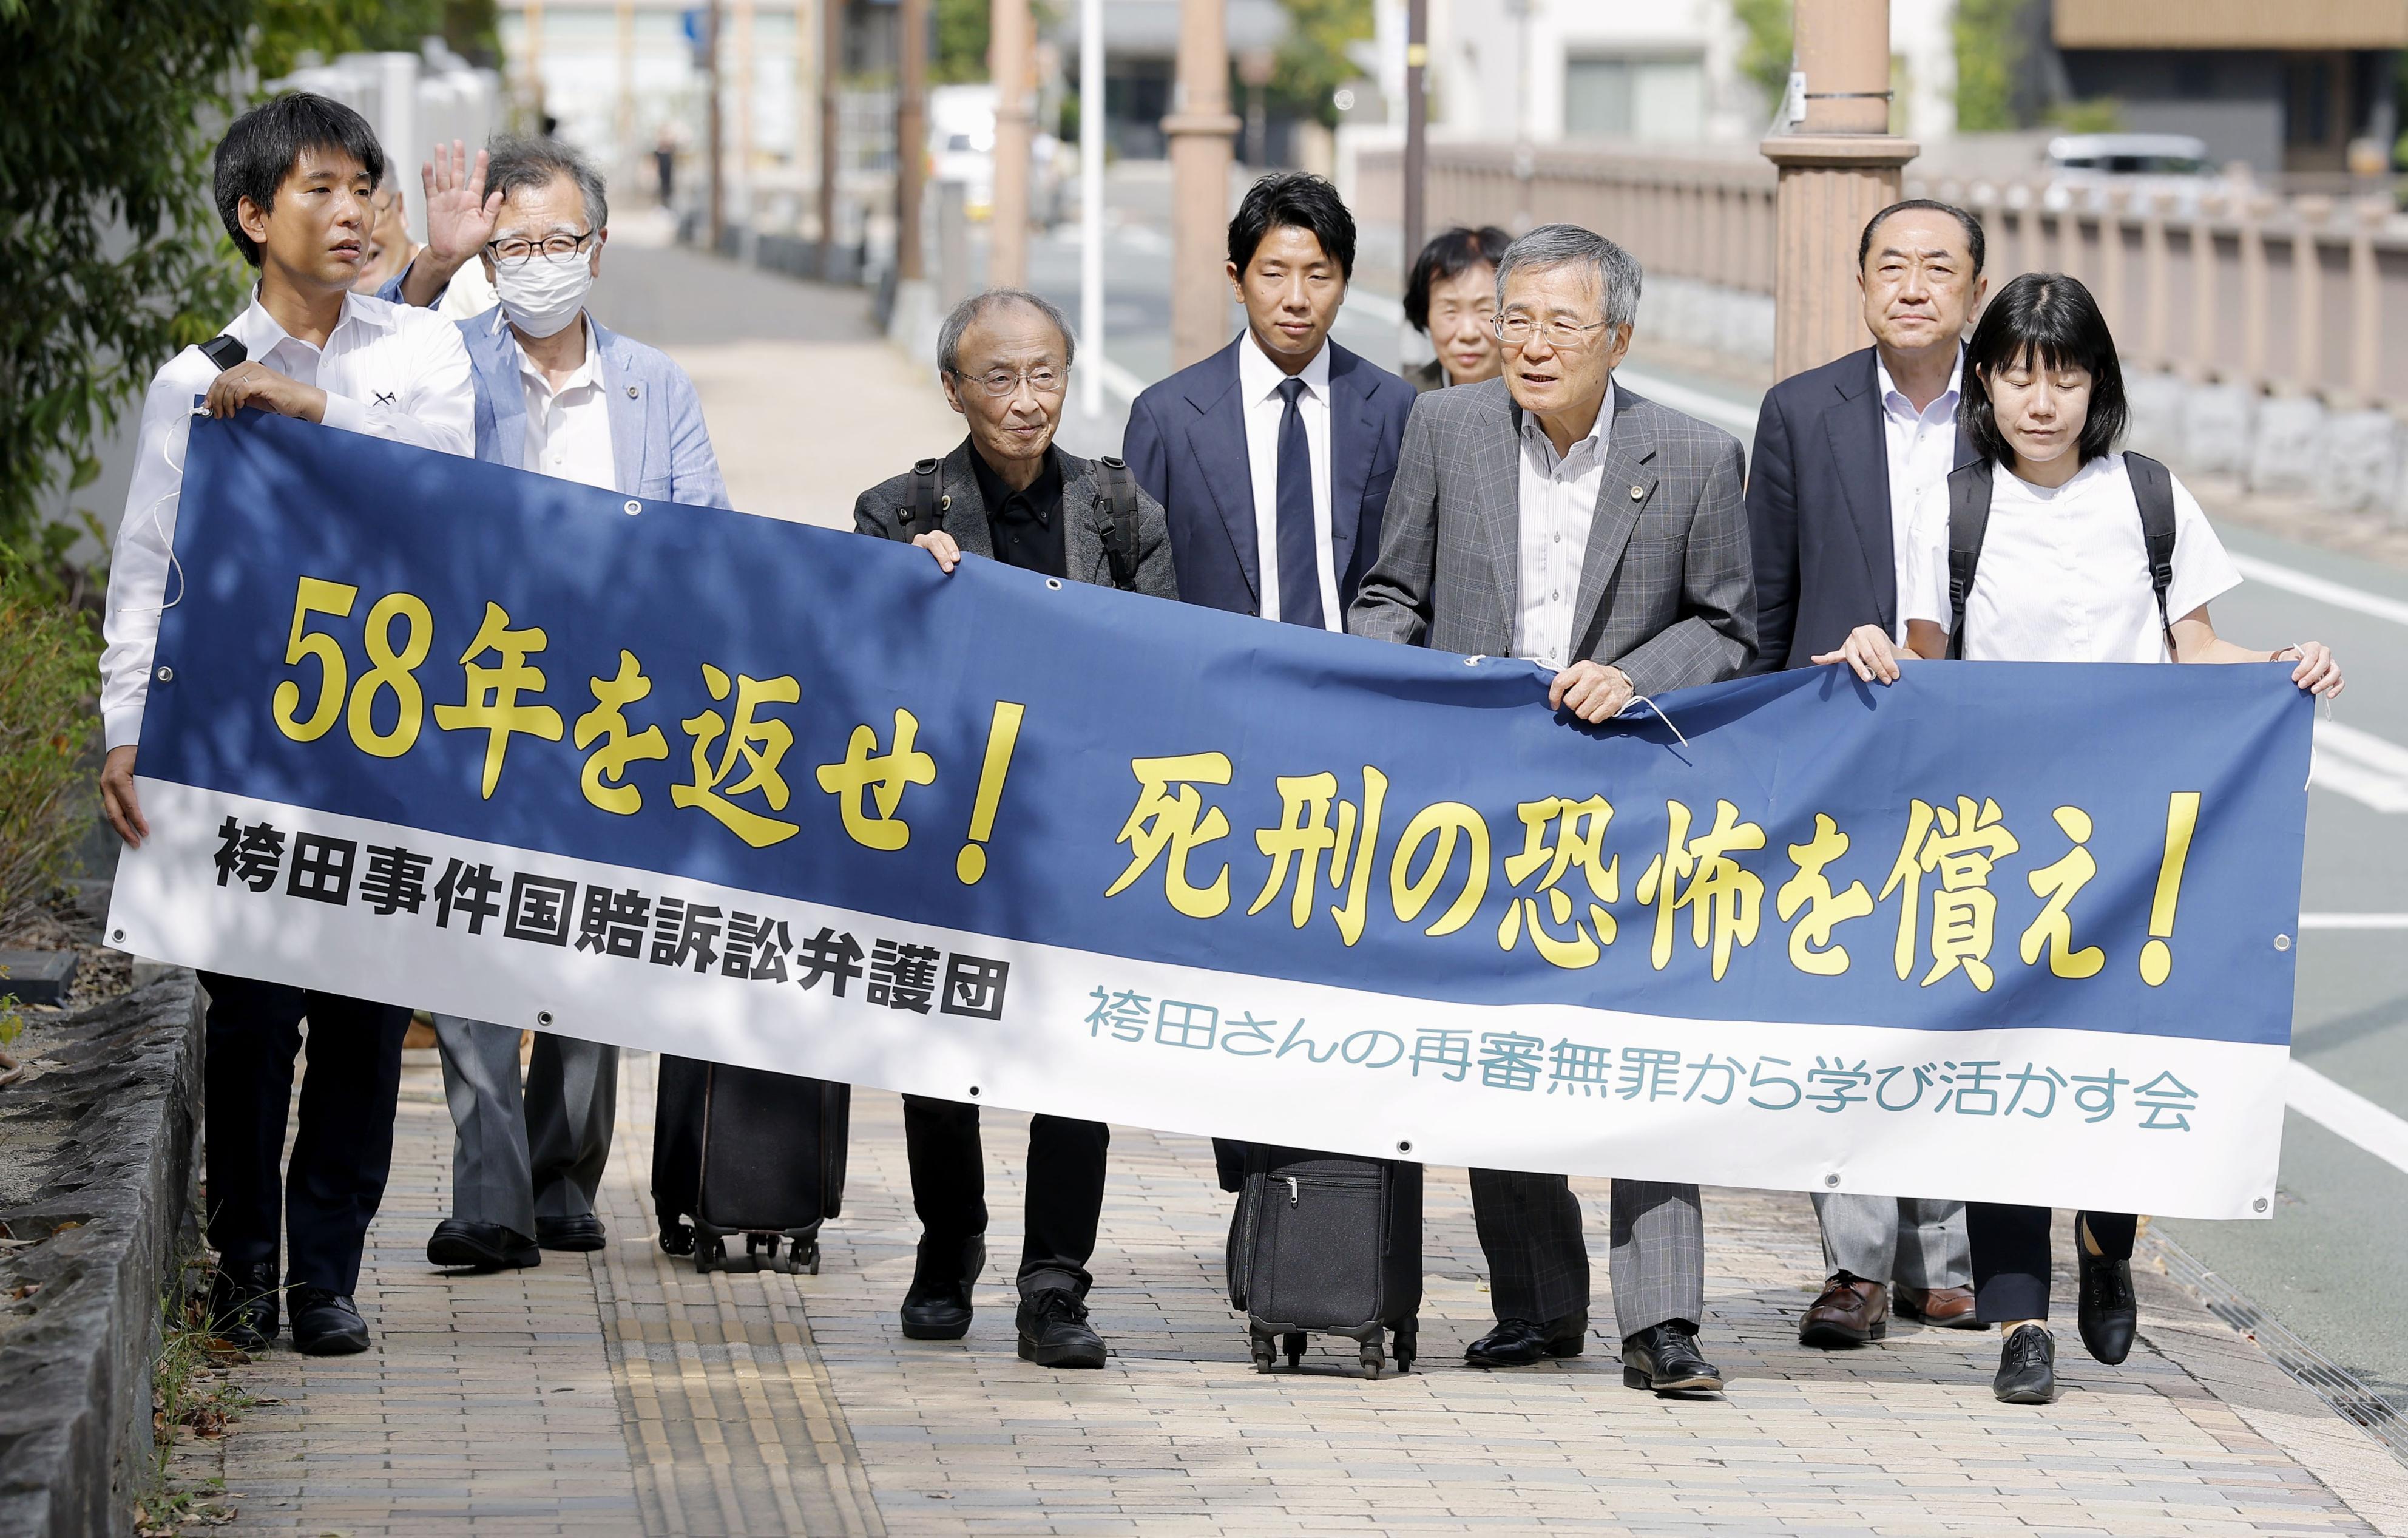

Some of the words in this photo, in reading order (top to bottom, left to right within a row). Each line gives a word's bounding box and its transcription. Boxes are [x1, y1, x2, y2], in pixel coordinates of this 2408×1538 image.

[272, 575, 1026, 886] 58年を返せ！
[1104, 751, 2202, 992] 死刑の恐怖を償え！
[212, 814, 1010, 1021] 袴田事件国賠訴訟弁護団
[1084, 984, 2199, 1133] 袴田さんの再審無罪から学び活かす会
